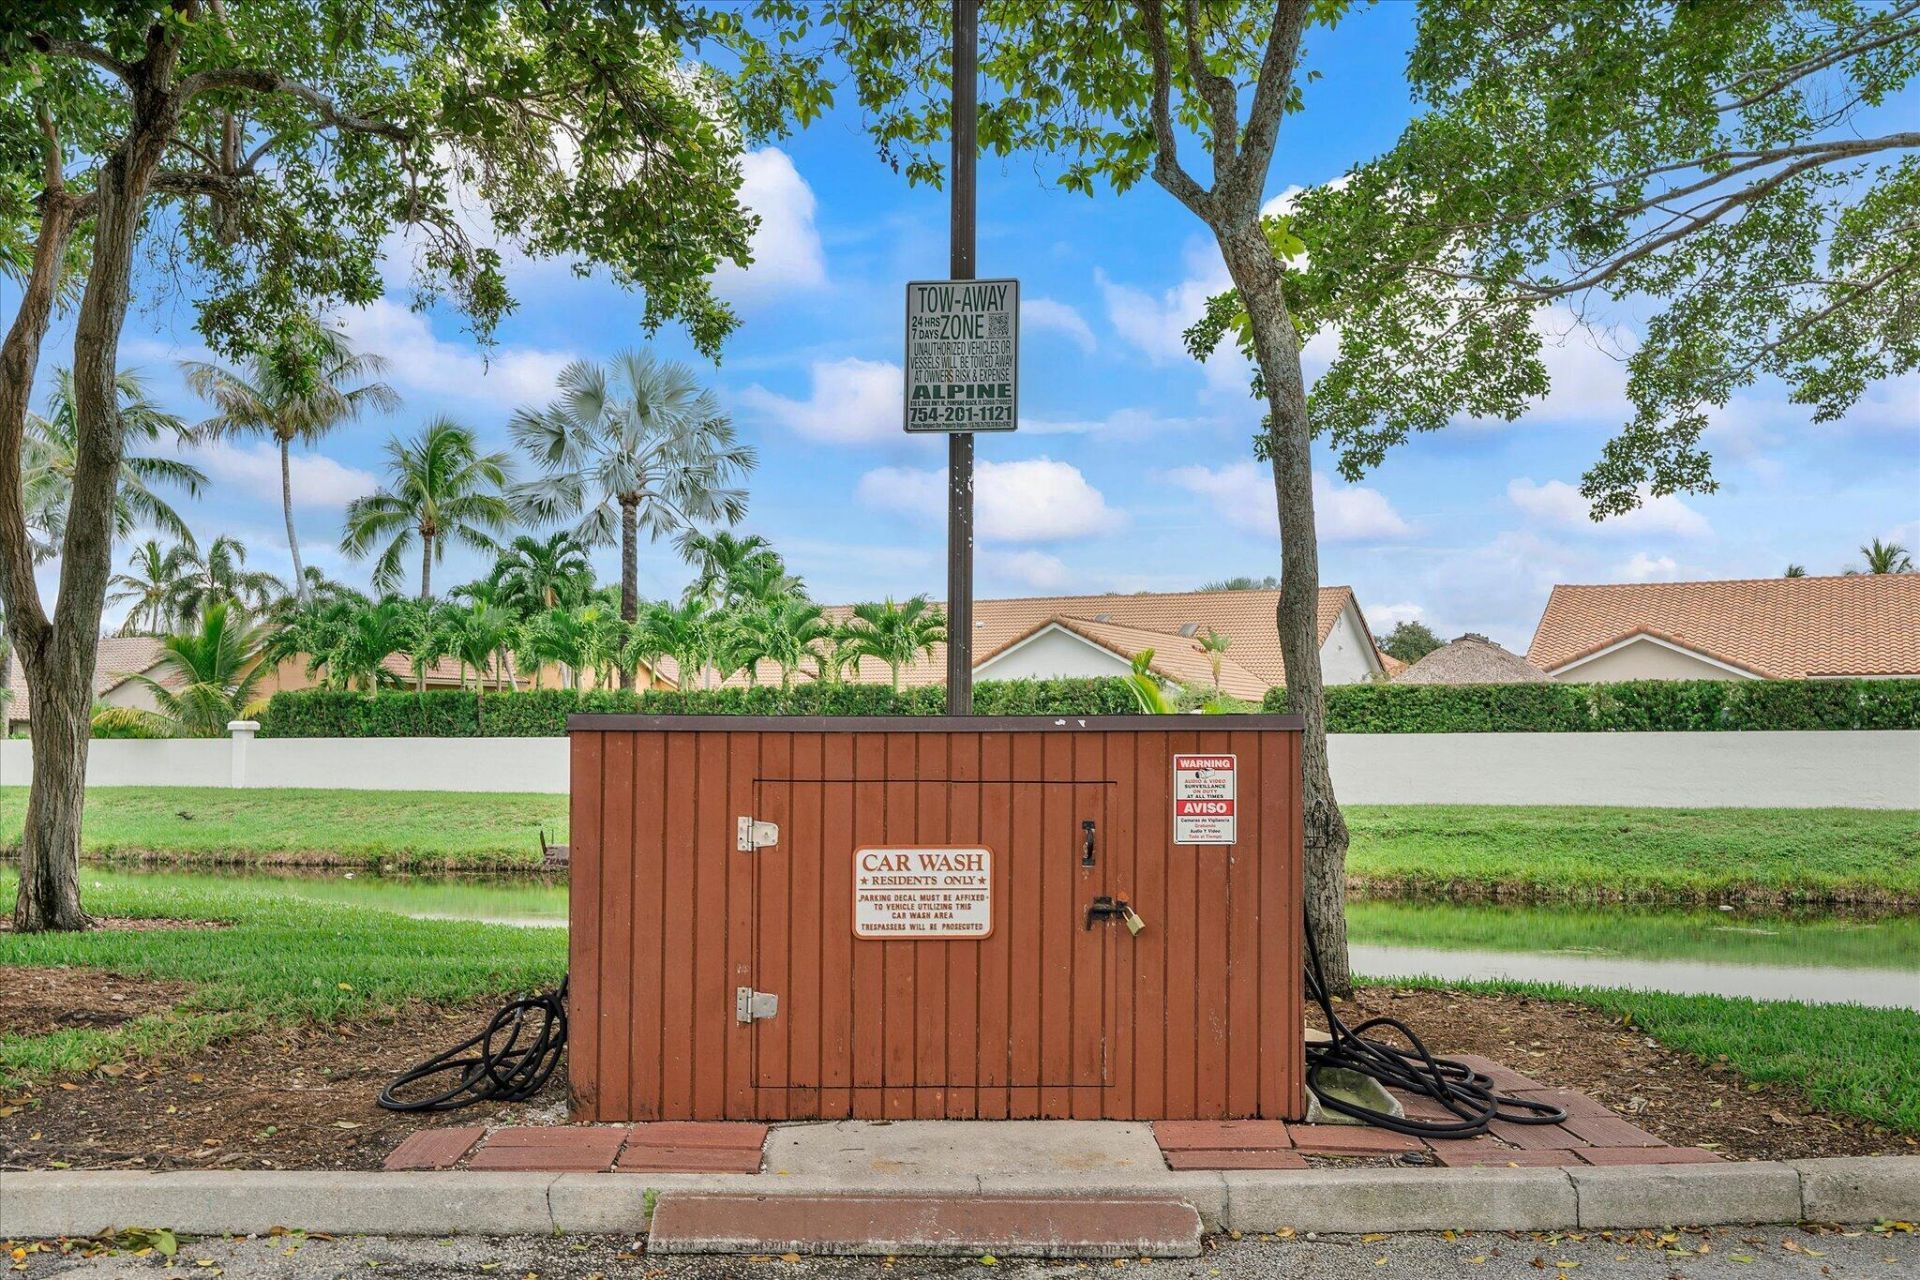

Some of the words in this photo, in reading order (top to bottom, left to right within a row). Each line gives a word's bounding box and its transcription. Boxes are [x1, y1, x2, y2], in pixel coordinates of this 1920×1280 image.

[918, 285, 1008, 313] TOW-AWAY
[912, 316, 923, 328] 24
[924, 317, 940, 327] HRS
[940, 314, 984, 340] ZONE
[912, 328, 917, 340] 7
[919, 330, 939, 340] DAYS
[914, 342, 966, 356] UNAUTHORIZED
[967, 341, 1000, 355] VEHICLES
[1000, 340, 1011, 354] OR
[910, 356, 940, 369] VESSELS
[941, 356, 957, 369] WILL
[960, 356, 969, 368] BE
[970, 356, 993, 368] TOWED
[995, 355, 1013, 368] AWAY
[914, 370, 924, 383] AT
[924, 369, 954, 383] OWNERS
[955, 369, 971, 382] RISK
[972, 369, 978, 382] &
[980, 368, 1010, 382] EXPENSE
[912, 384, 1012, 399] ALPINE
[910, 406, 1012, 422] 754-201-1121
[1180, 760, 1230, 768] WARNING
[1184, 802, 1227, 814] AVISO
[862, 854, 911, 872] CAR
[918, 854, 984, 871] WASH
[872, 876, 938, 885] RESIDENTS
[944, 876, 976, 885] ONLY
